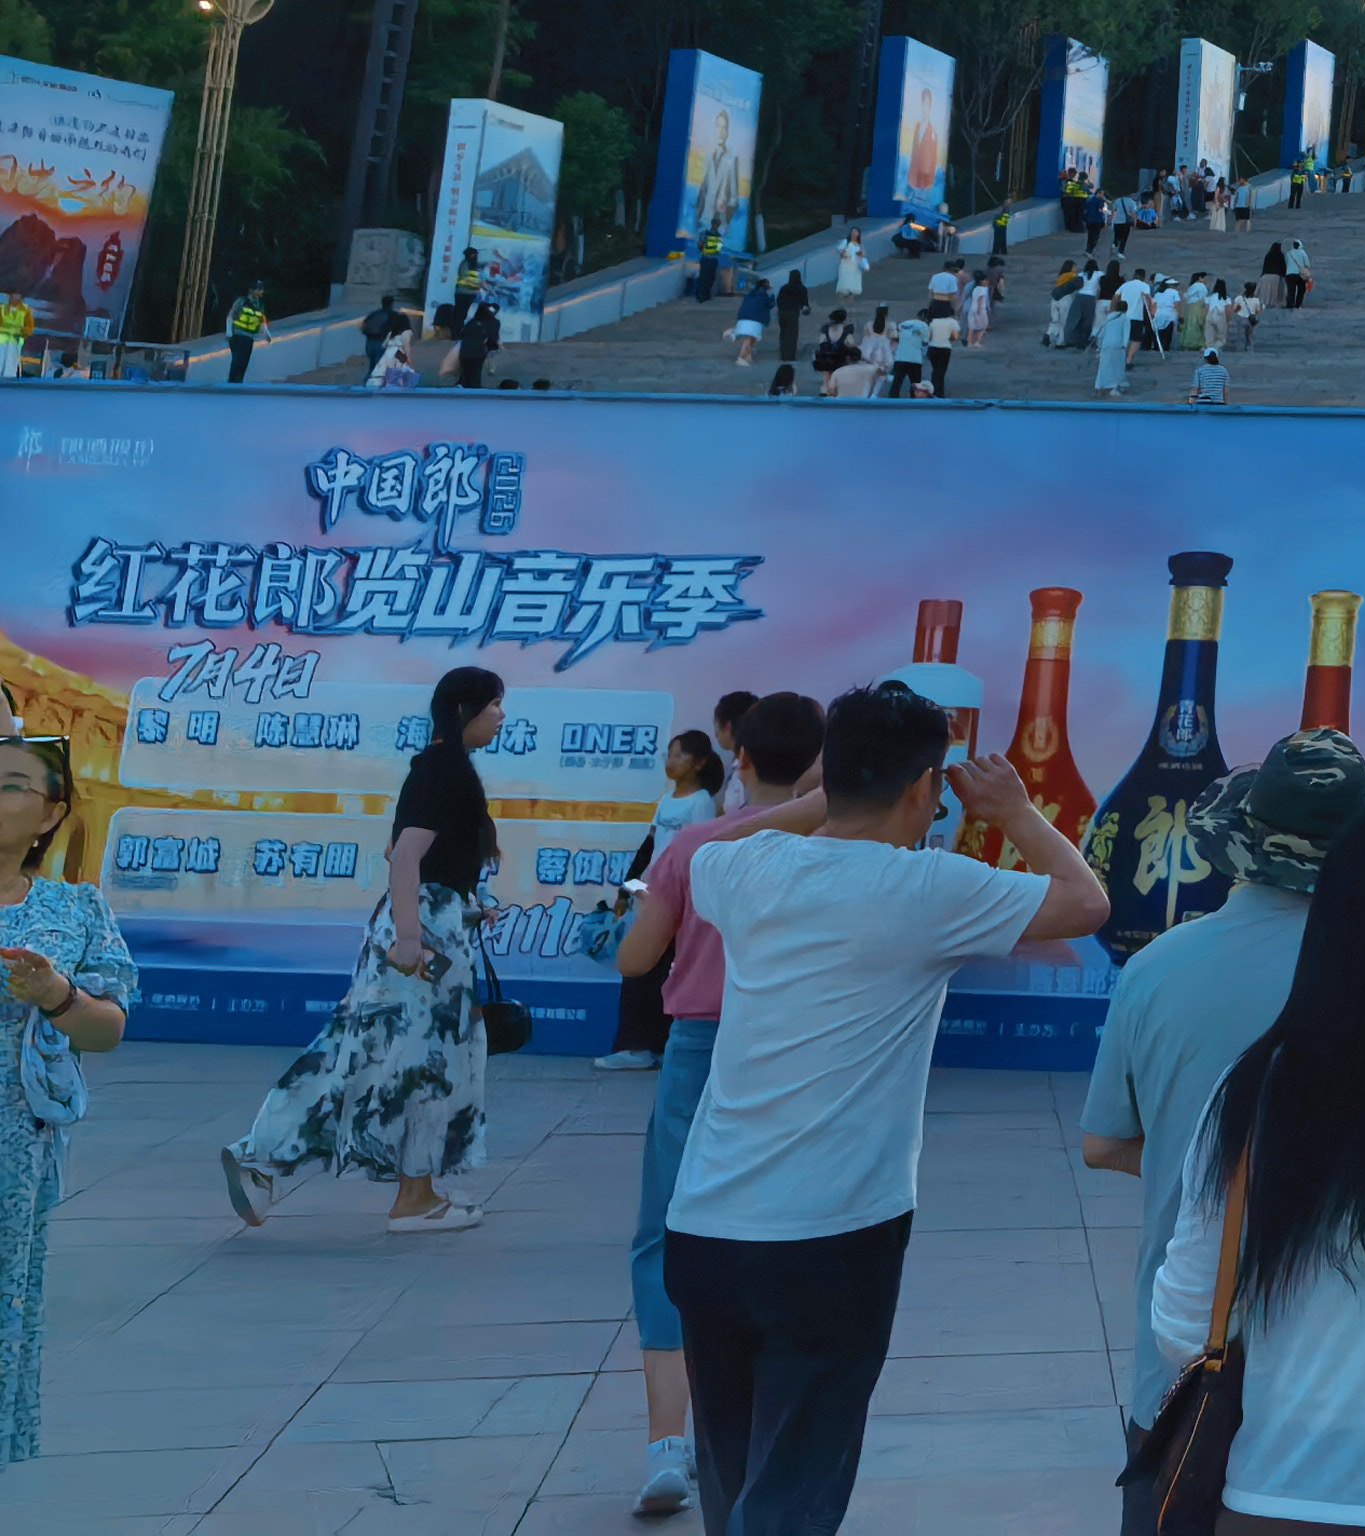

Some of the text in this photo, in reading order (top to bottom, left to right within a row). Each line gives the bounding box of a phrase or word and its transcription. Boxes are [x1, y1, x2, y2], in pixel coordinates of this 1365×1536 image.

[311, 441, 483, 549] 中国郎
[70, 540, 762, 671] 红花郎览山音乐季
[158, 641, 320, 704] 7月4日
[255, 712, 360, 751] 陈慧琳
[561, 723, 659, 755] ONER
[116, 833, 220, 874] 郭富城
[254, 838, 359, 879] 苏有朋
[1133, 795, 1213, 929] 郎
